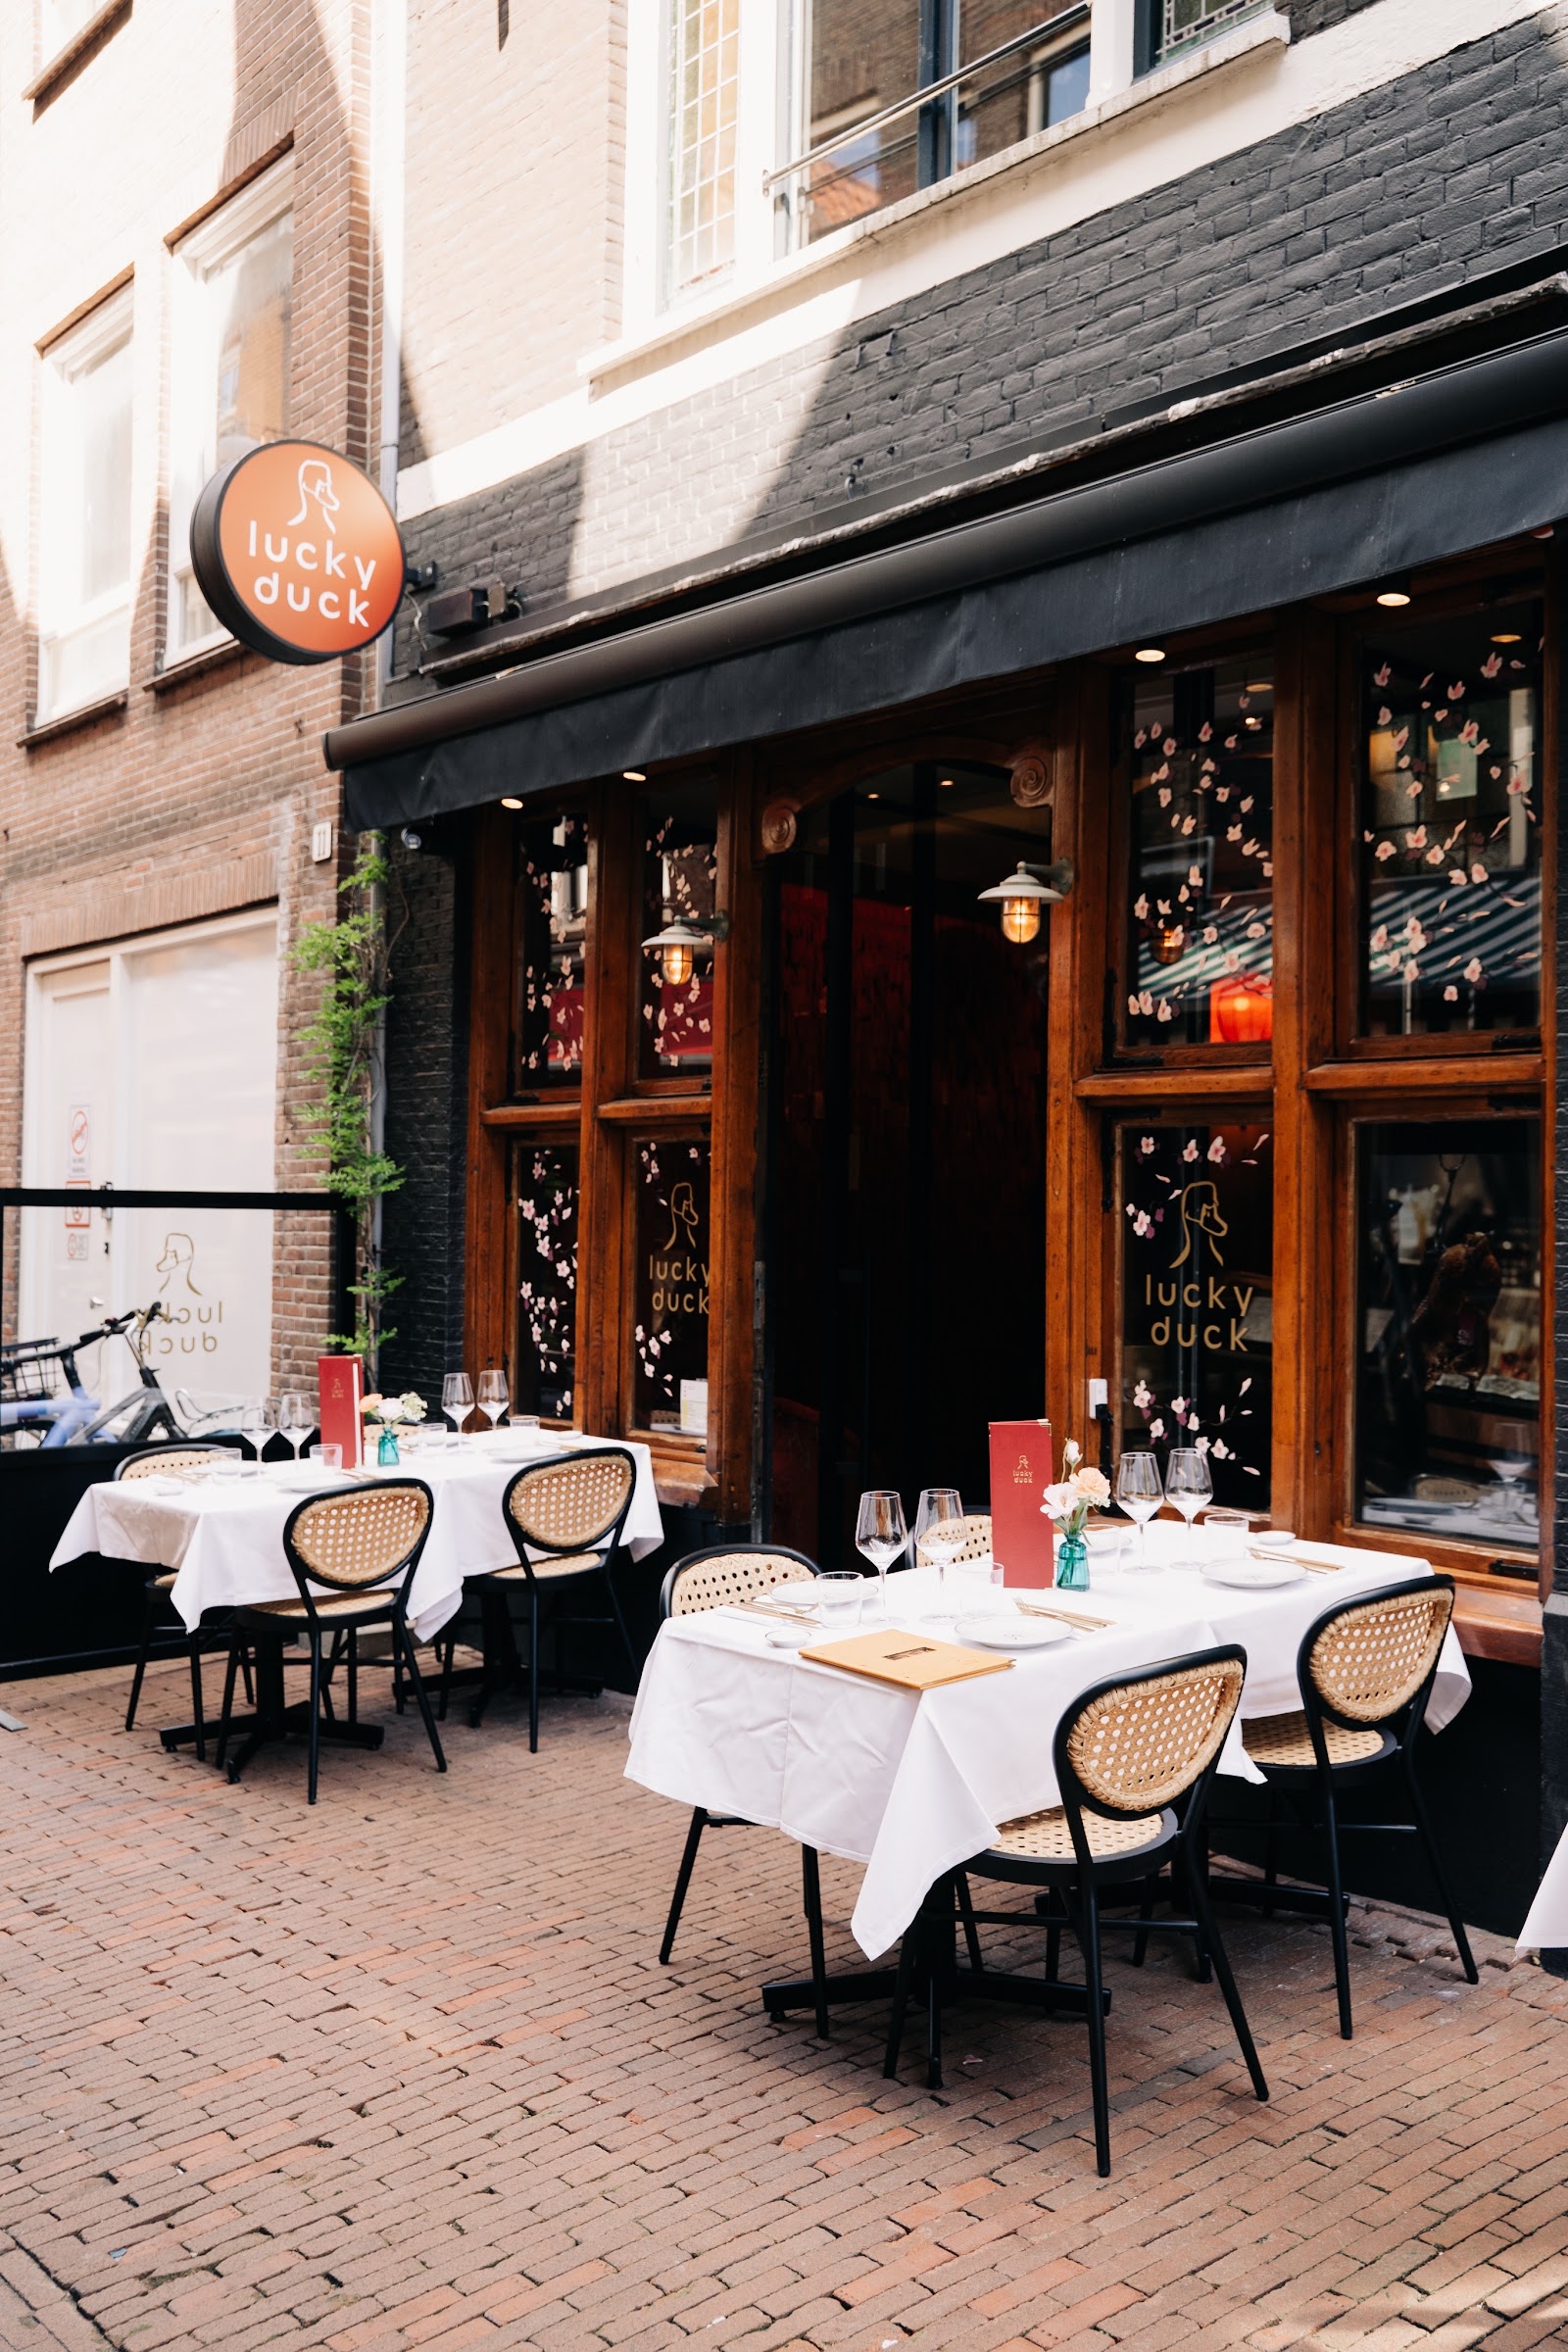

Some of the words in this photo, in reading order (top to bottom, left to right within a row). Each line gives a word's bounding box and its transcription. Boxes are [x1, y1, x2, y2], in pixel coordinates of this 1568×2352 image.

[249, 520, 376, 591] lucky
[254, 572, 369, 627] duck
[649, 1254, 710, 1287] lucky
[652, 1287, 710, 1314] duck
[1146, 1274, 1253, 1317] lucky
[1151, 1316, 1249, 1351] duck
